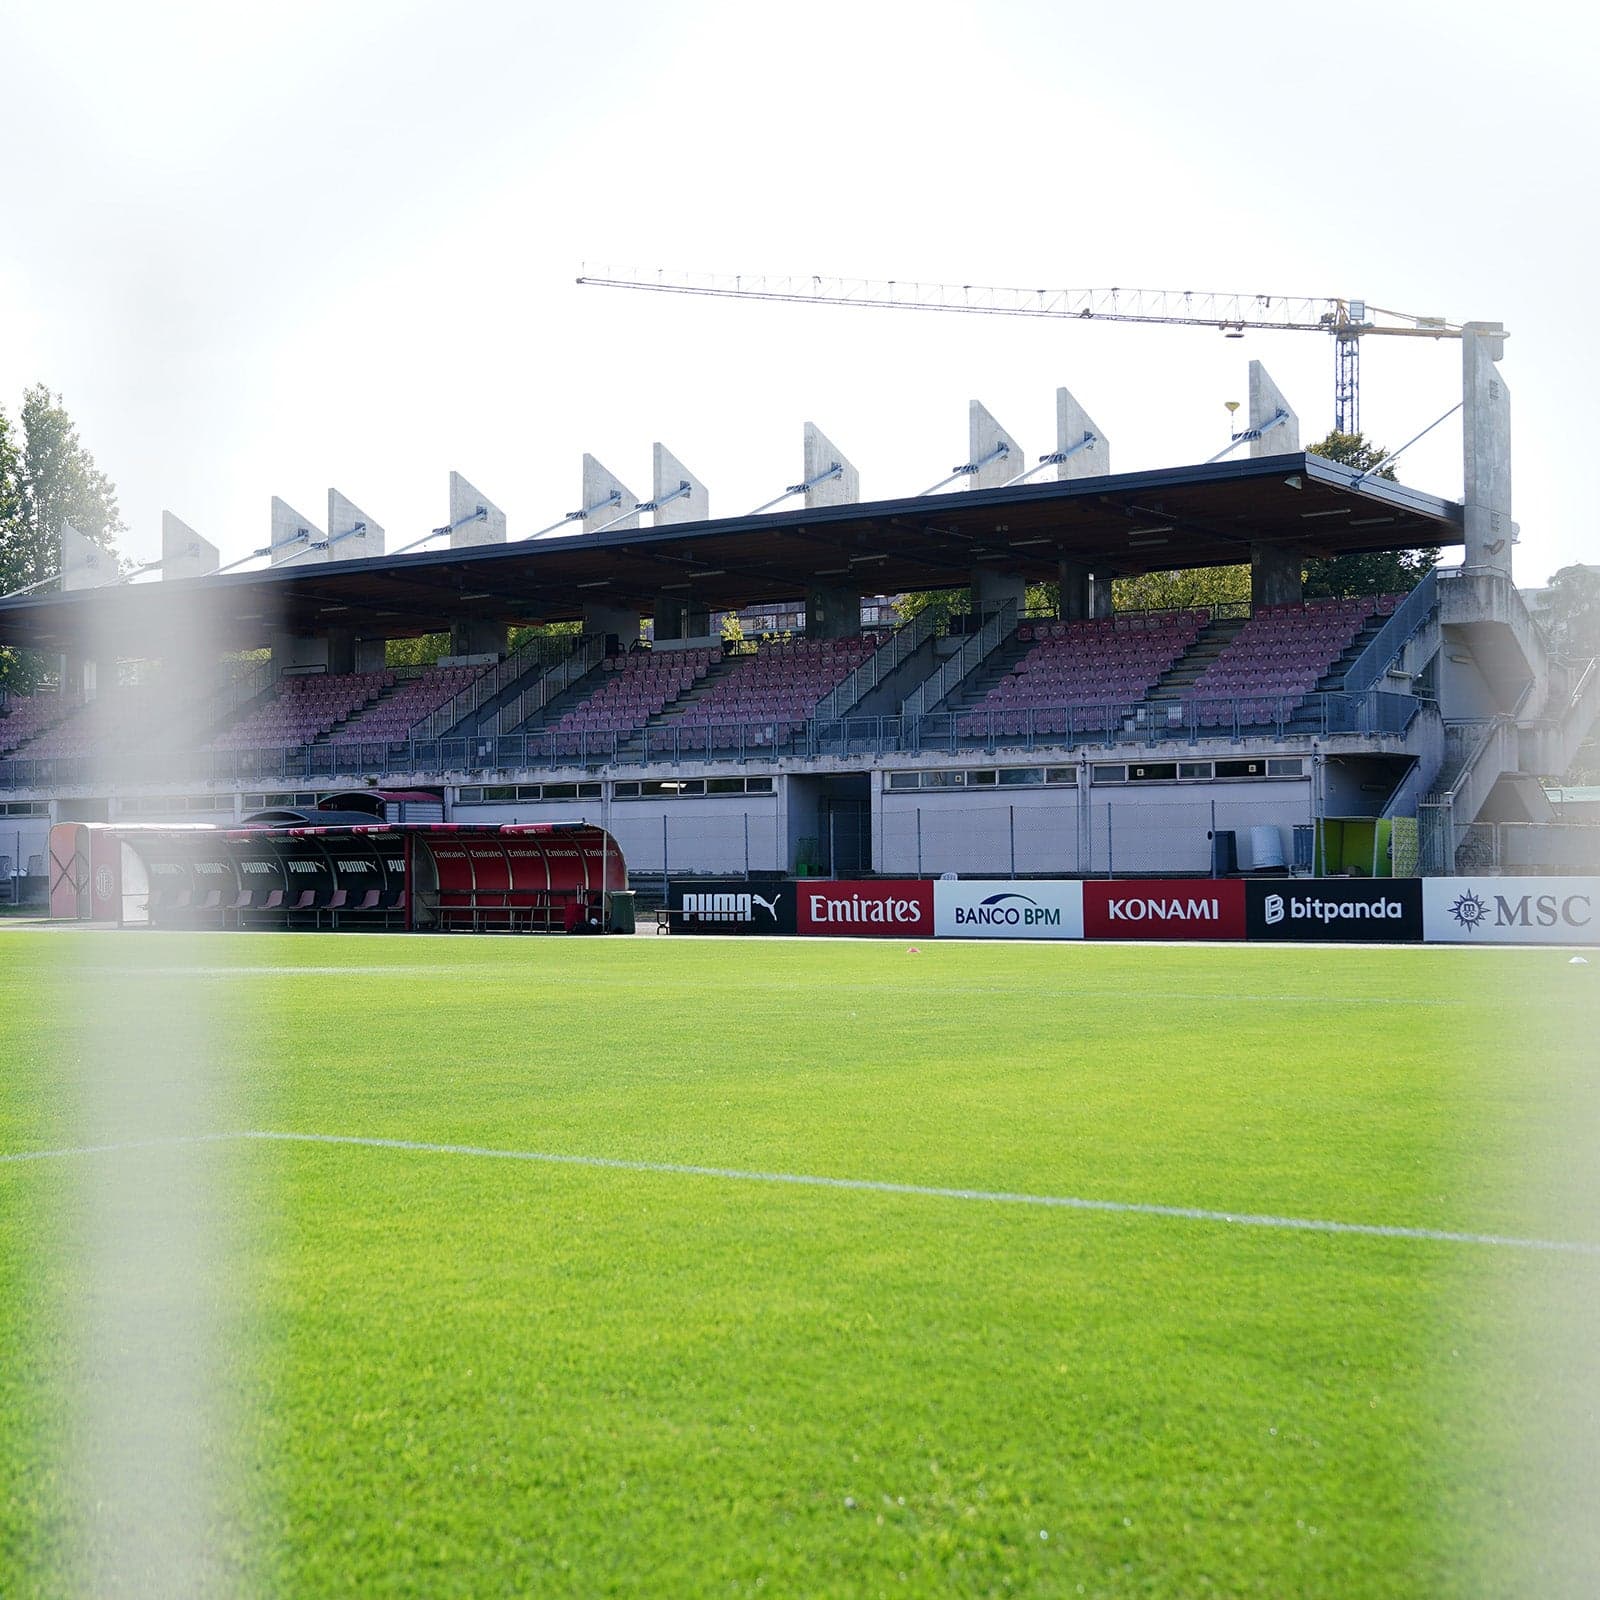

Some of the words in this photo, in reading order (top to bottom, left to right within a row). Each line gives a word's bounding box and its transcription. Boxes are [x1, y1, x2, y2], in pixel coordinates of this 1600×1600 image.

[469, 849, 503, 858] Emirates
[507, 849, 541, 857] Emirates
[241, 862, 270, 874] PUMA
[288, 861, 318, 873] PUMA
[338, 861, 368, 873] PUMA
[683, 893, 752, 922] PUMA
[809, 894, 921, 922] Emirates
[955, 907, 1020, 925] BANCO
[1024, 908, 1061, 926] BPM
[1108, 899, 1219, 920] KONAMI
[1290, 897, 1402, 924] bitpanda
[1493, 895, 1593, 927] MSC
